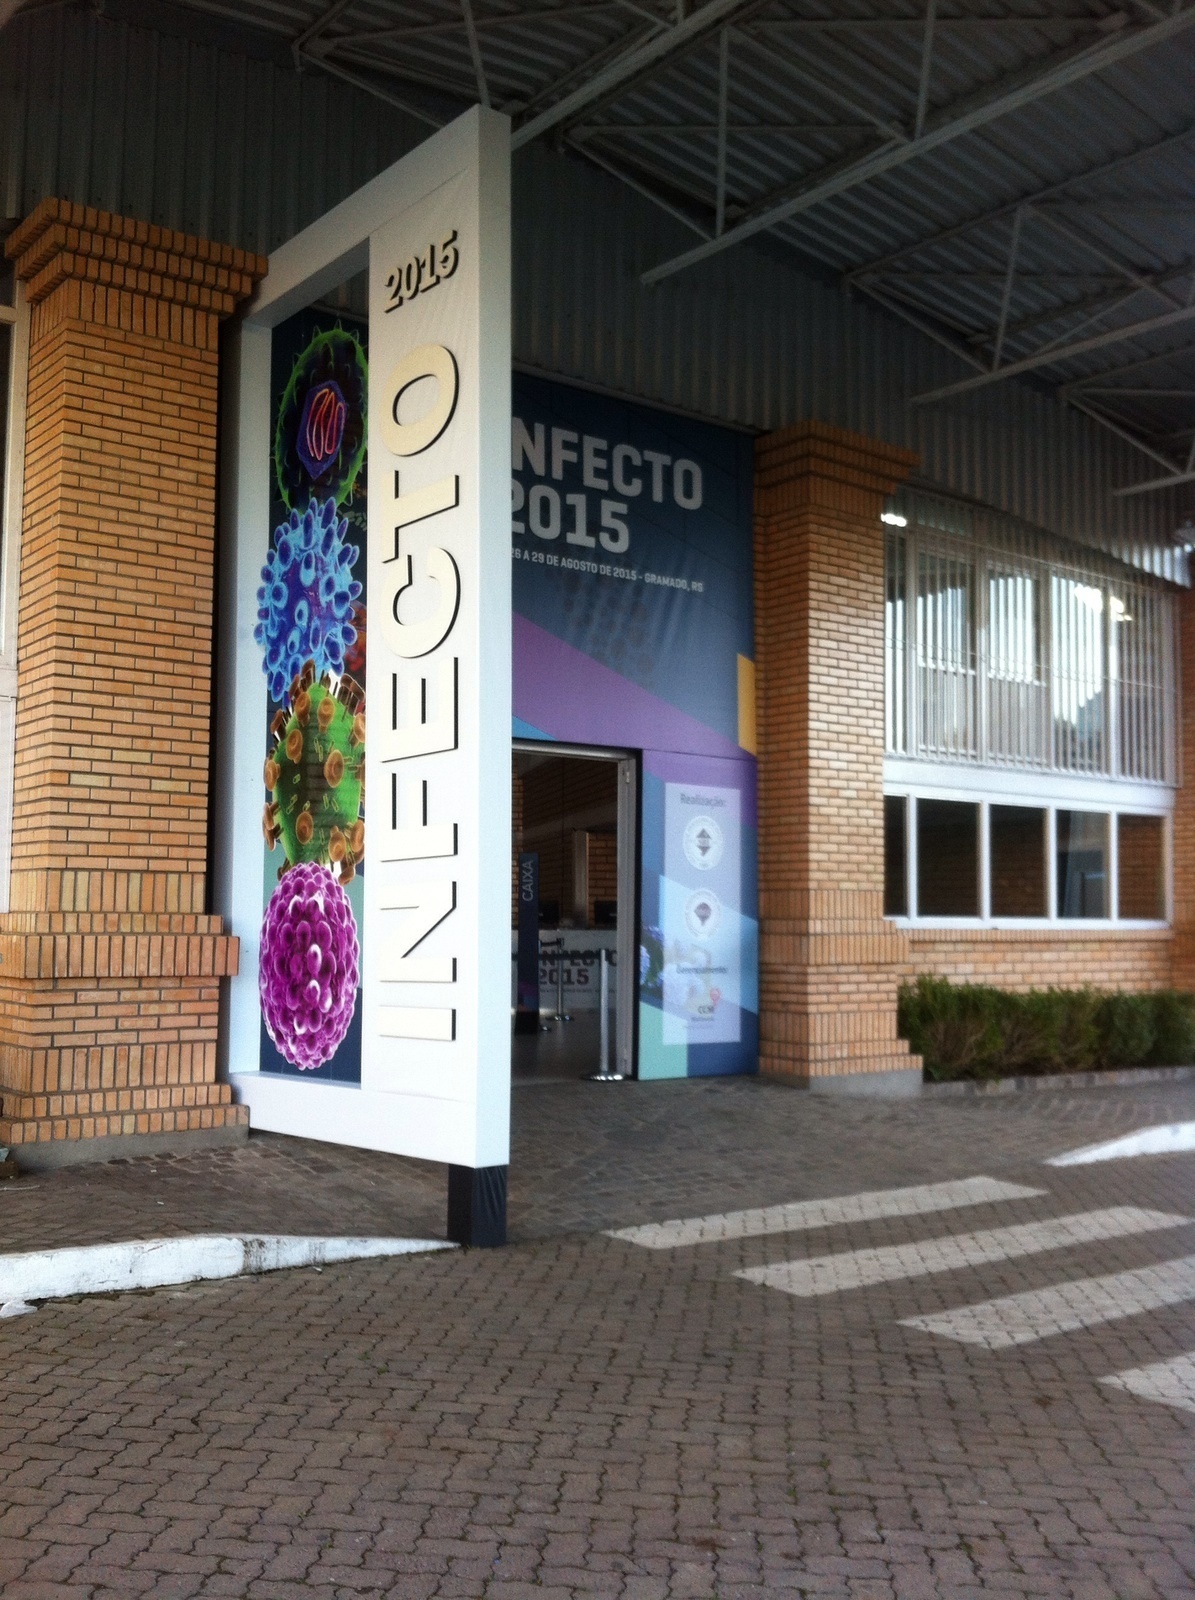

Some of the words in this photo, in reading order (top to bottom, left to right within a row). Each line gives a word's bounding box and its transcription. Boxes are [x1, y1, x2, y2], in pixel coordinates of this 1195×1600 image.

[384, 229, 459, 314] 2015
[511, 416, 703, 510] NFECTO
[523, 549, 530, 561] A
[531, 551, 545, 564] 29
[546, 554, 559, 567] DE
[560, 557, 598, 574] AGOSTO
[599, 565, 612, 577] DE
[613, 567, 637, 581] 2015
[644, 573, 690, 592] GRAMADO,
[691, 581, 704, 593] RS
[379, 343, 460, 1042] INFECTO
[521, 860, 534, 901] CAIXA
